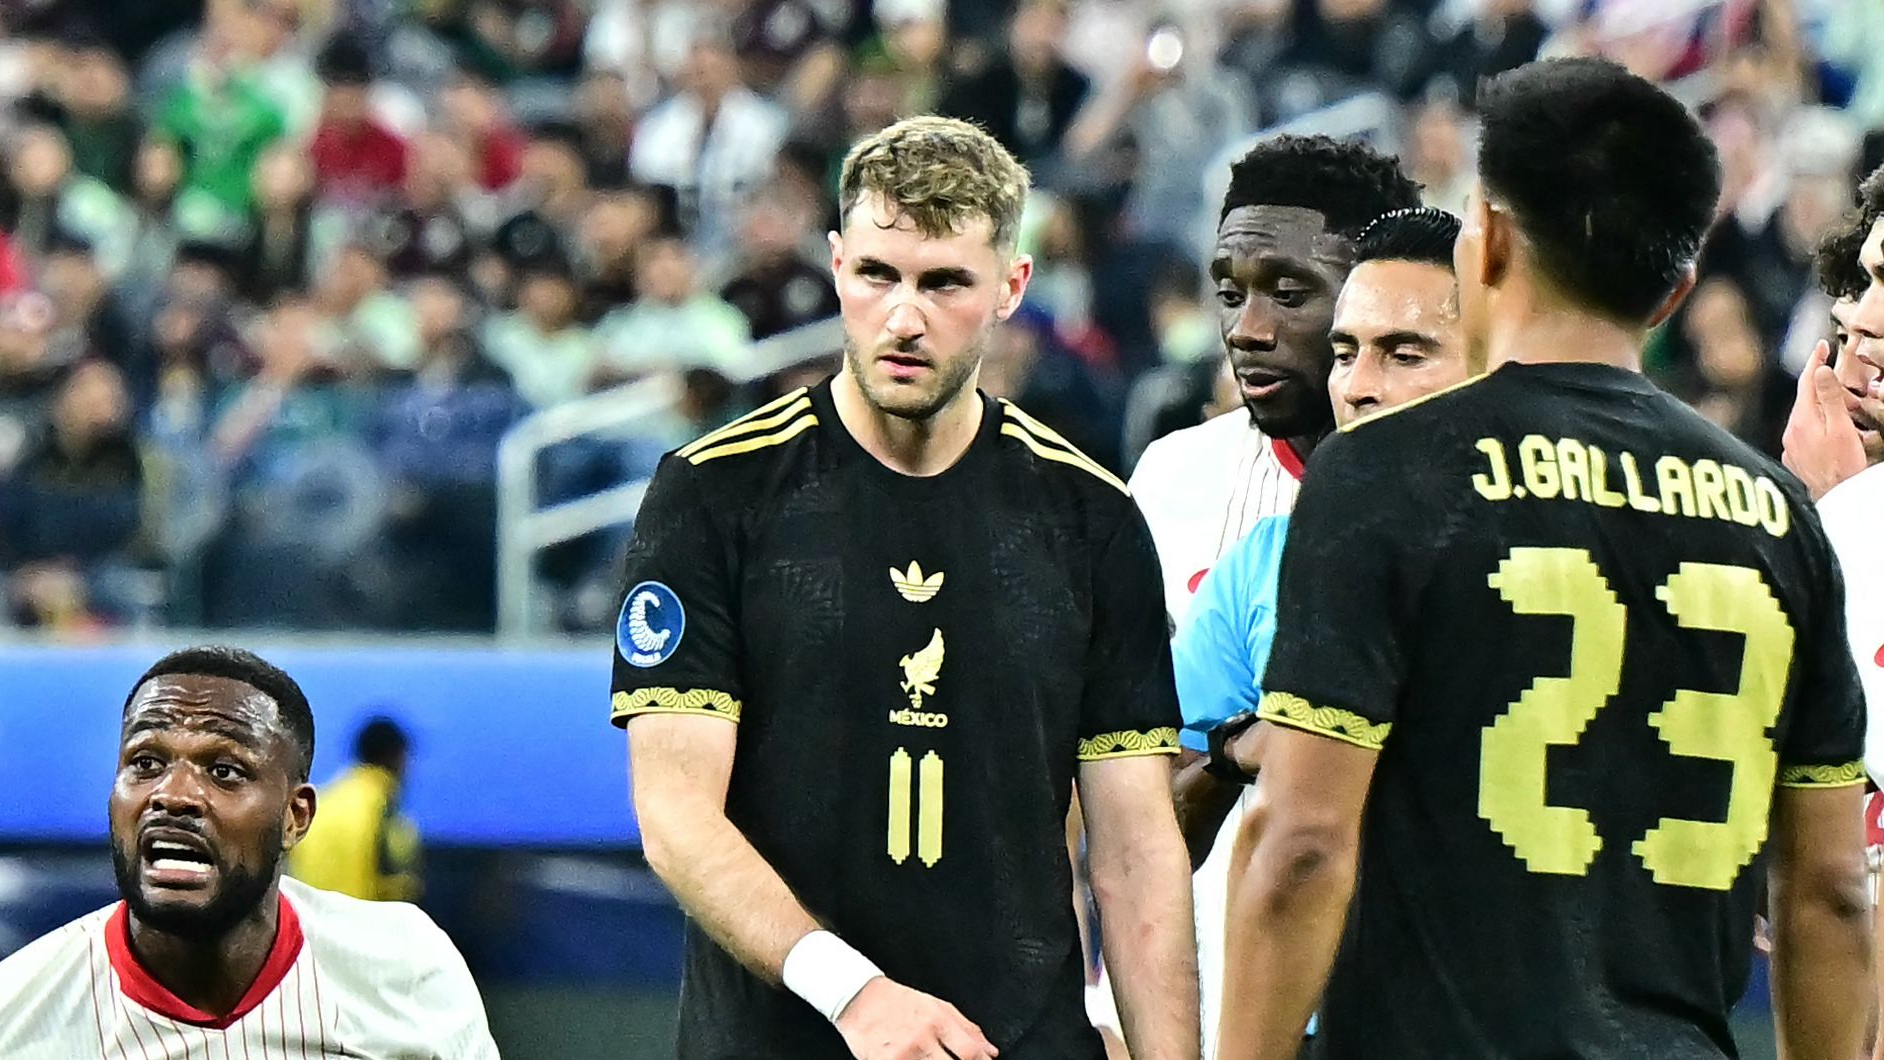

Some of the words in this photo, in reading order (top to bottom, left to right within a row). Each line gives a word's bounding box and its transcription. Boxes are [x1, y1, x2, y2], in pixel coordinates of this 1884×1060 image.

[1471, 434, 1790, 538] J.GALLARDO
[889, 708, 949, 728] MÉXICO
[1476, 546, 1795, 891] 23
[887, 746, 944, 868] 11
